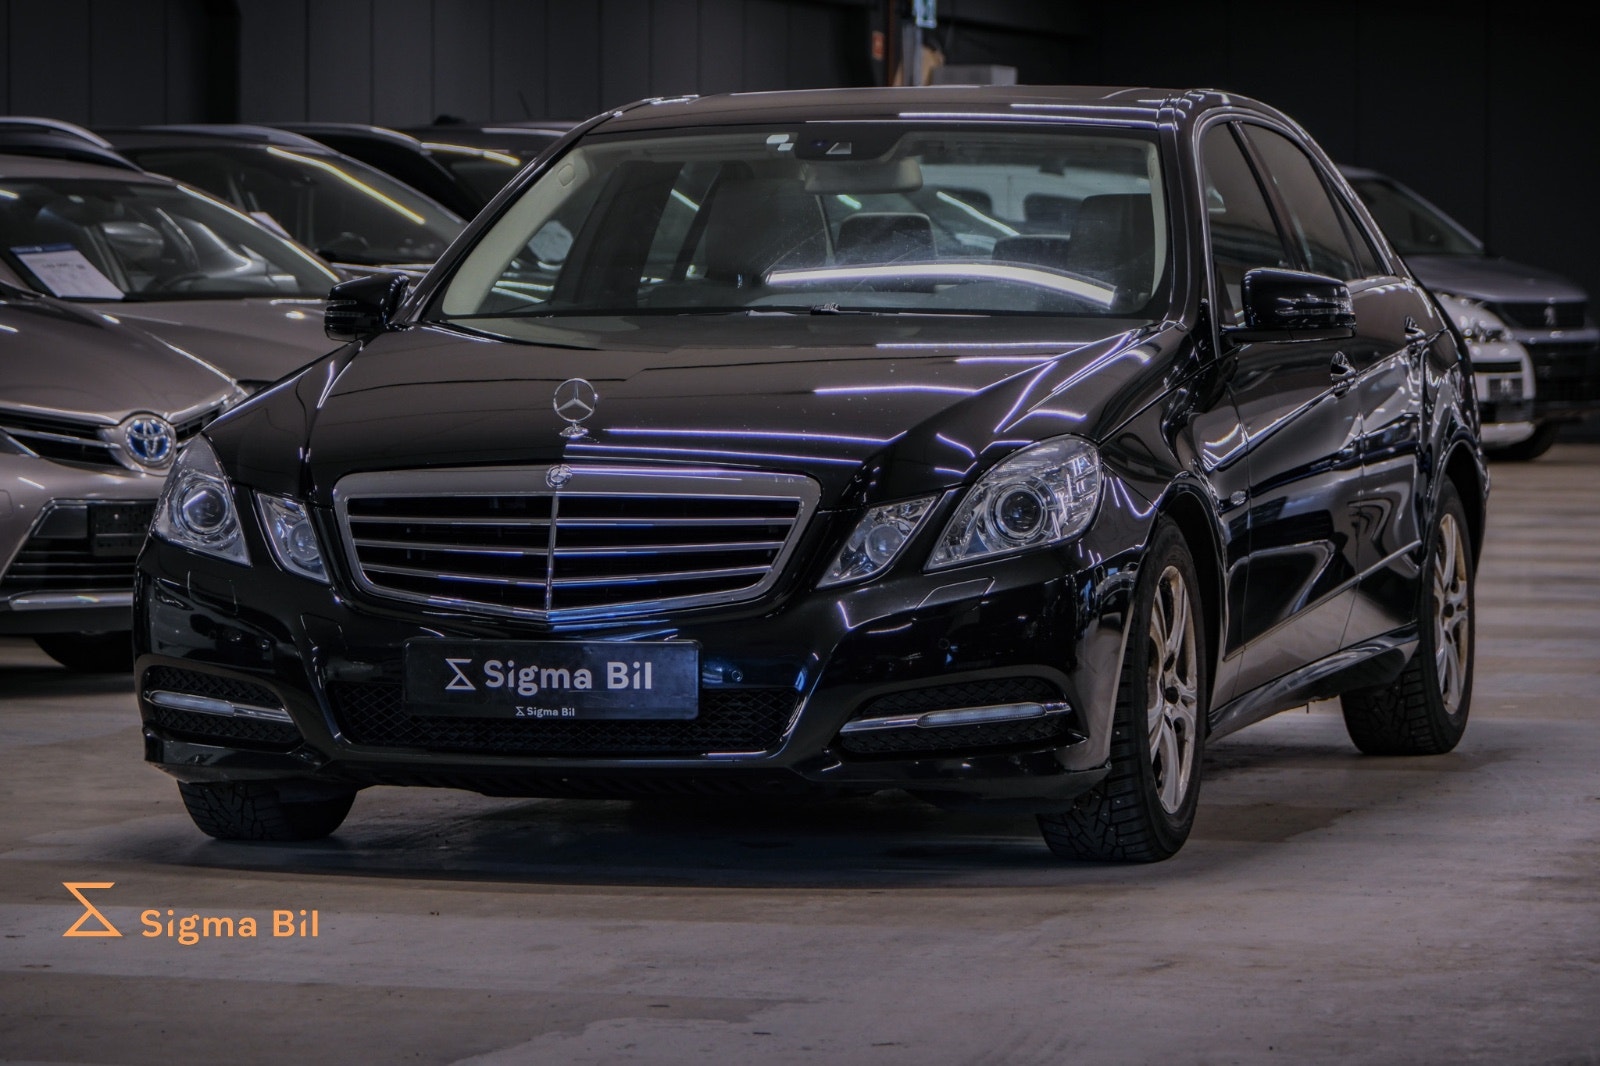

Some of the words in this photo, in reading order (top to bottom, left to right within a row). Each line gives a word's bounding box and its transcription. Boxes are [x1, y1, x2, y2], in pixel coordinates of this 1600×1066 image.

[483, 659, 592, 696] Sigma
[606, 661, 652, 690] Bil
[526, 706, 559, 718] Sigma
[561, 707, 575, 717] Bil
